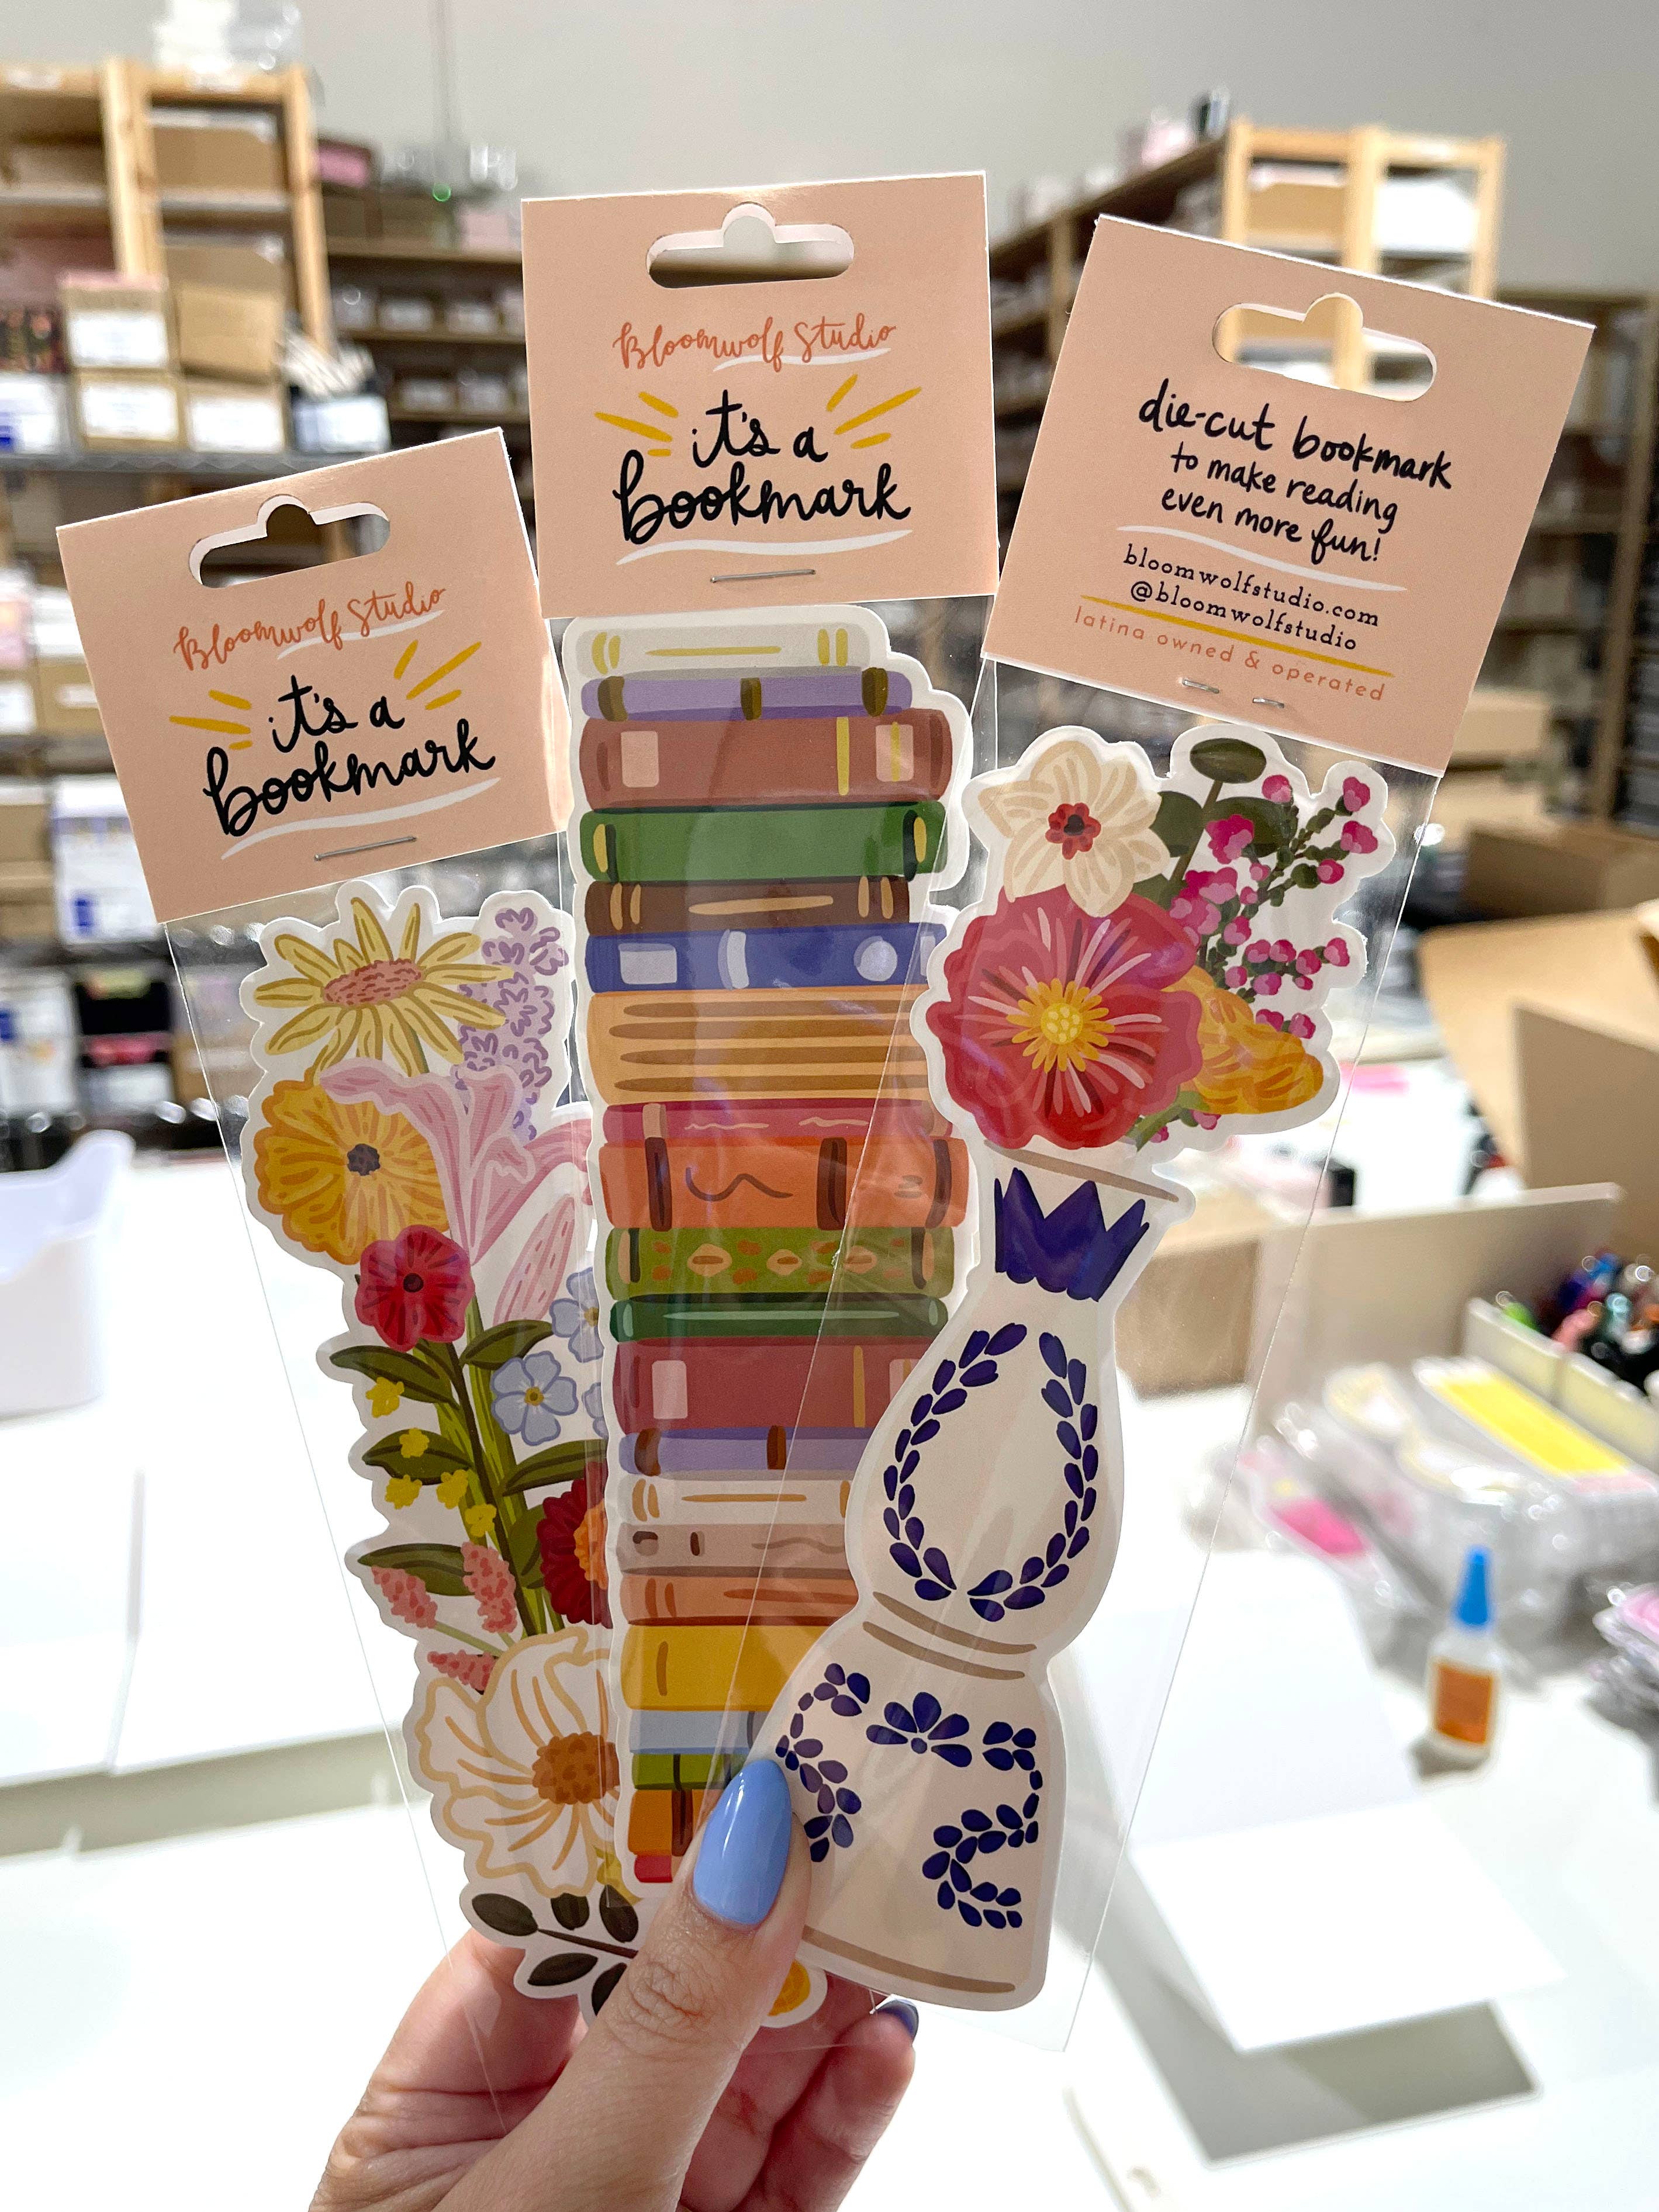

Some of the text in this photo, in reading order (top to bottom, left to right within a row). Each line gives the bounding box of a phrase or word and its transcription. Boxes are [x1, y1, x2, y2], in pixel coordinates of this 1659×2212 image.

[613, 313, 897, 372] Bloomwolf Studio
[692, 389, 828, 468] it's a
[1139, 379, 1451, 489] die-cut bookmark
[613, 449, 911, 545] bookmark
[1162, 489, 1380, 564] even more fun!
[1171, 442, 1398, 534] to make reading
[174, 581, 446, 671] Bloomwolf Studio
[1123, 545, 1378, 628] bloomwolfstudio.com
[1130, 580, 1357, 650] @bloomwolfstudio
[1074, 605, 1385, 702] latina owned & operated
[269, 676, 406, 753] it's a
[203, 720, 495, 836] bookmark
